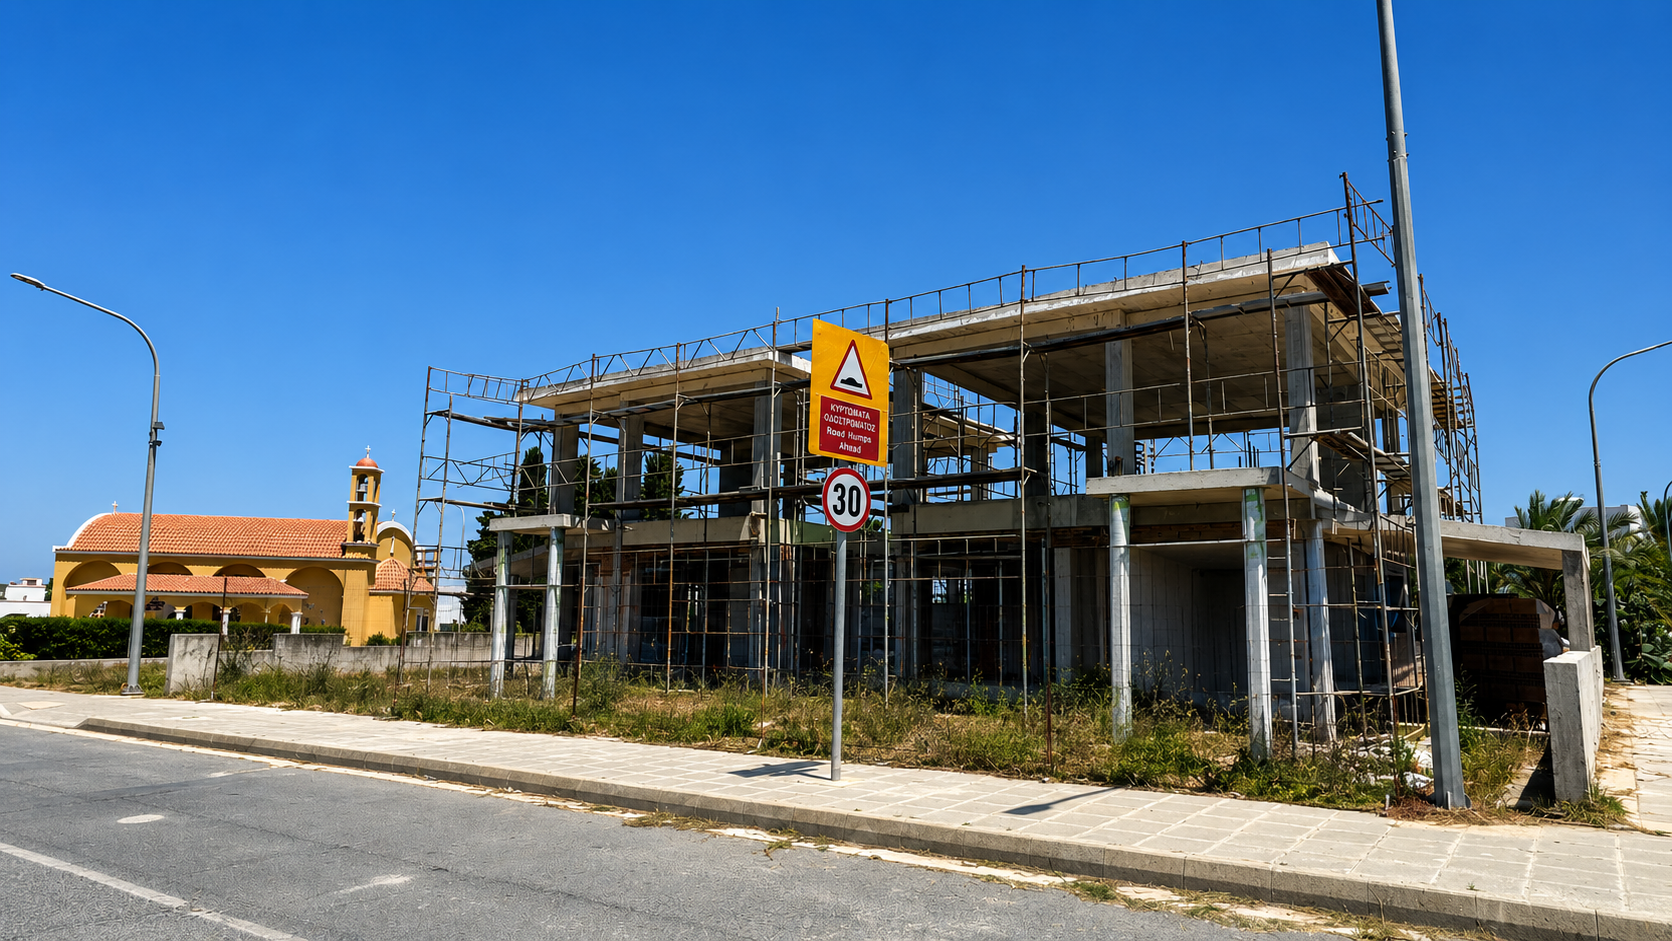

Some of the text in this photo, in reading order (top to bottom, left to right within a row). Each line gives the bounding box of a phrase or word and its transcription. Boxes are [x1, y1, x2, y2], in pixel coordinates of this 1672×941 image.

[826, 426, 872, 444] Road Humps
[832, 482, 861, 517] 30
